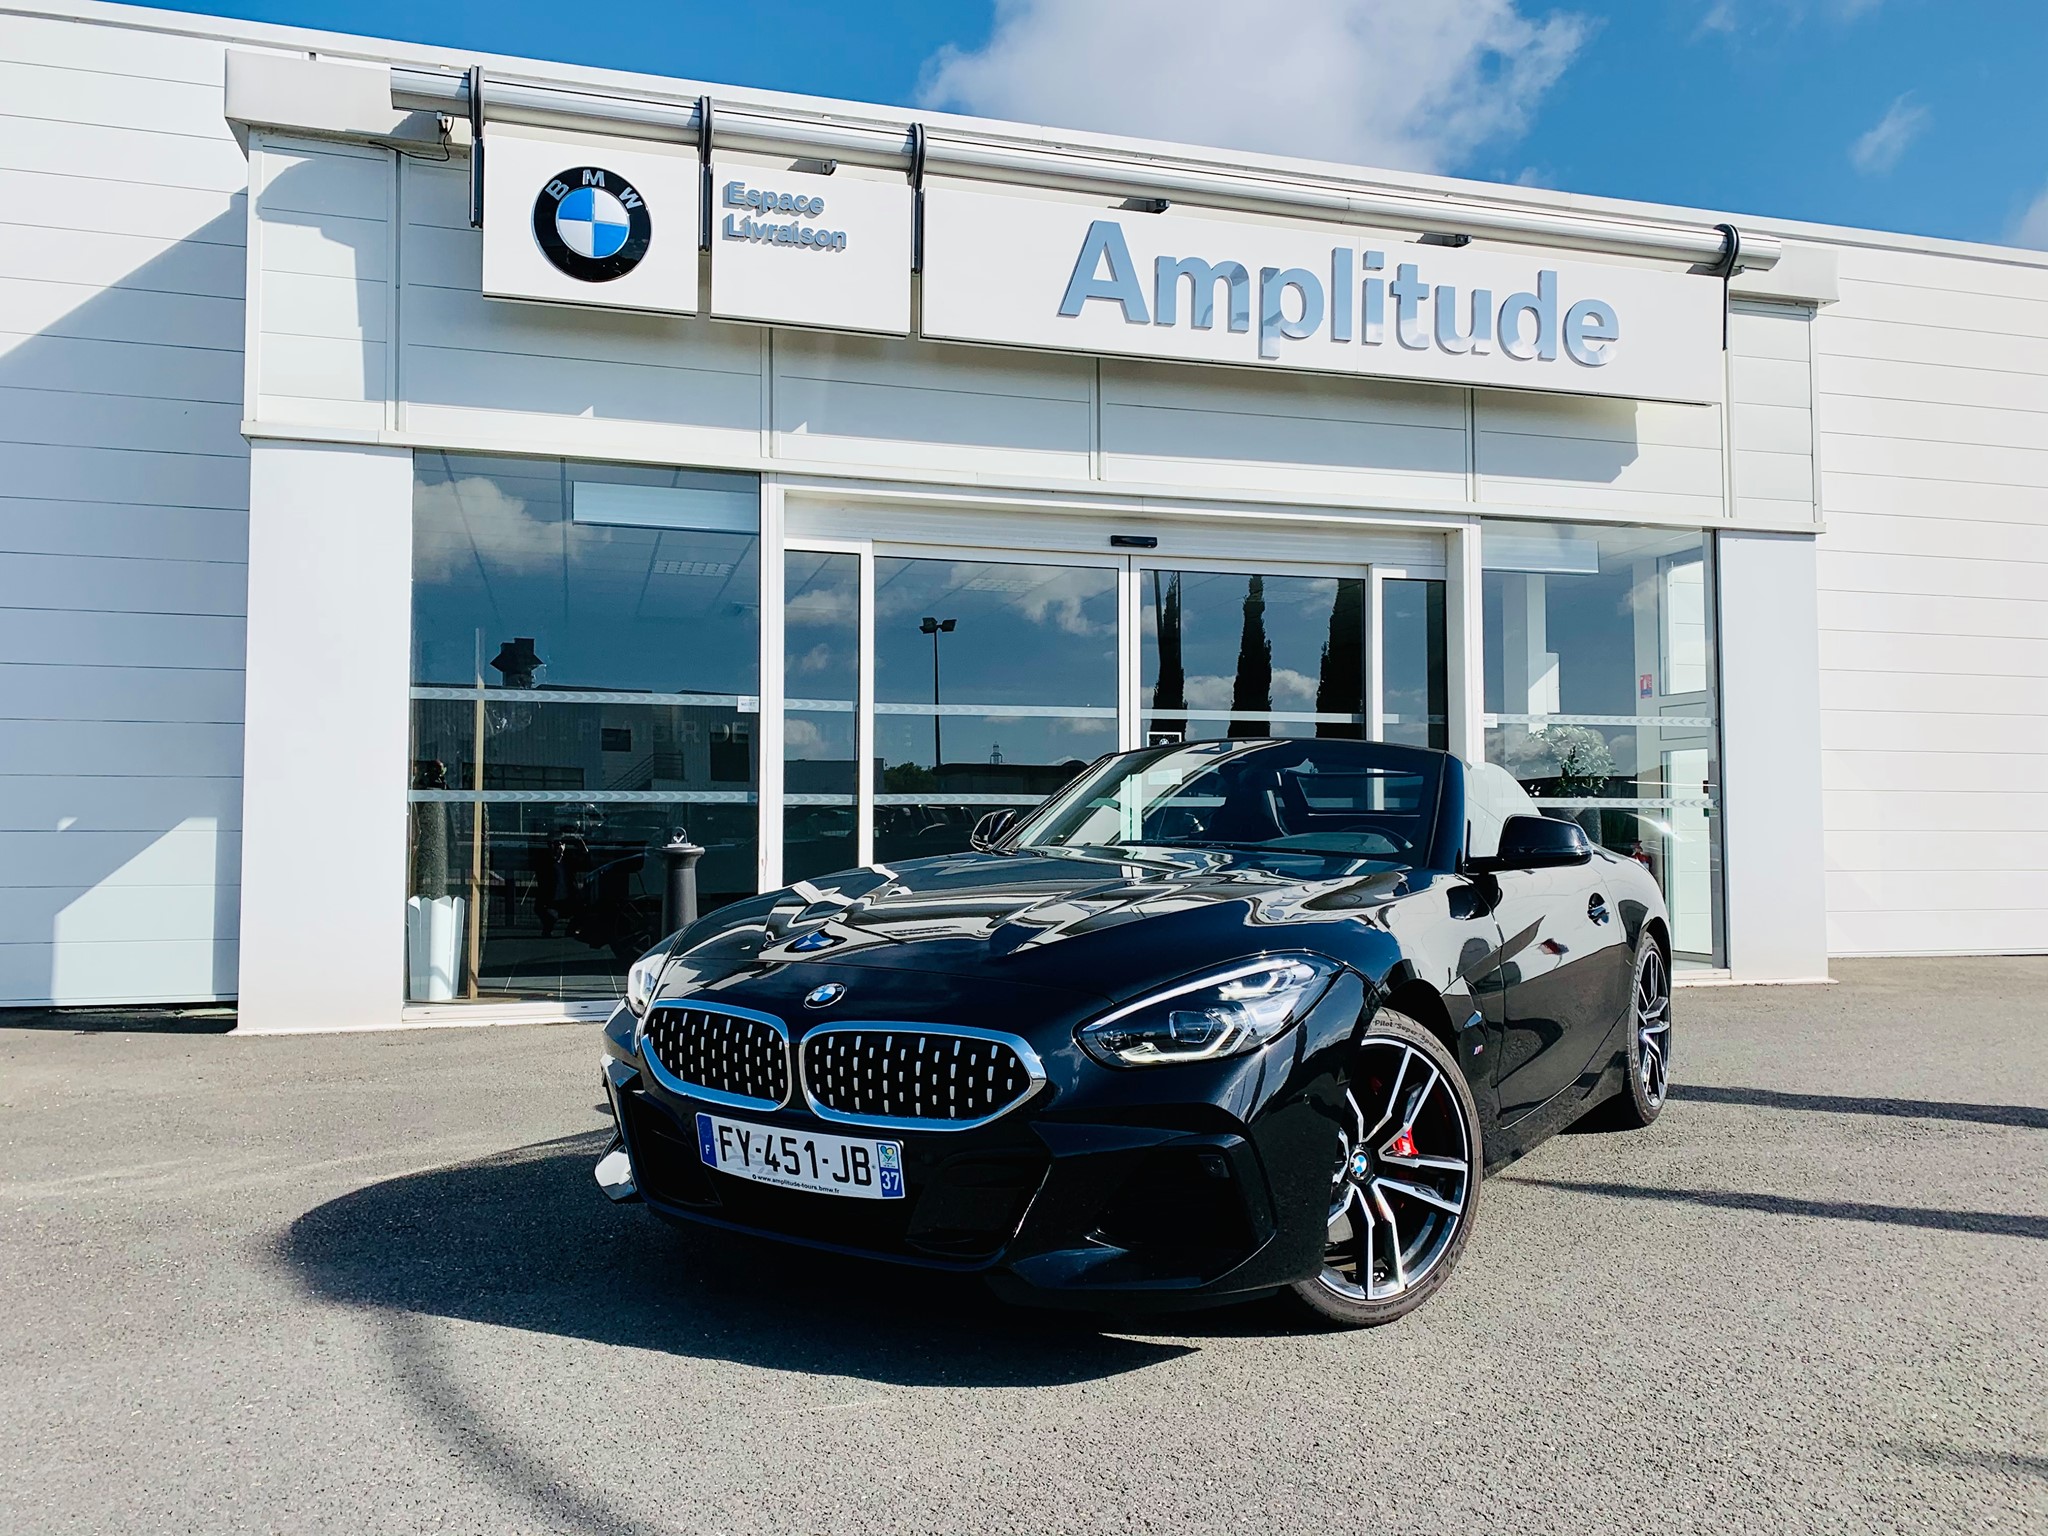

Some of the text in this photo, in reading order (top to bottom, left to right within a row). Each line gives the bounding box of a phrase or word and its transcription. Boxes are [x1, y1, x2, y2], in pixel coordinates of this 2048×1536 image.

[545, 169, 643, 209] BMW
[723, 181, 825, 214] Espace
[722, 213, 847, 250] Livraison
[1056, 219, 1619, 367] Amplitude
[1375, 1019, 1393, 1028] Pilot
[1397, 1023, 1418, 1035] Super
[1420, 1033, 1440, 1053] Sport
[705, 1144, 711, 1155] F
[718, 1125, 872, 1187] FY-451-JB
[757, 1175, 840, 1194] www.amplitude-tours.bmw.fr
[881, 1171, 900, 1191] 37
